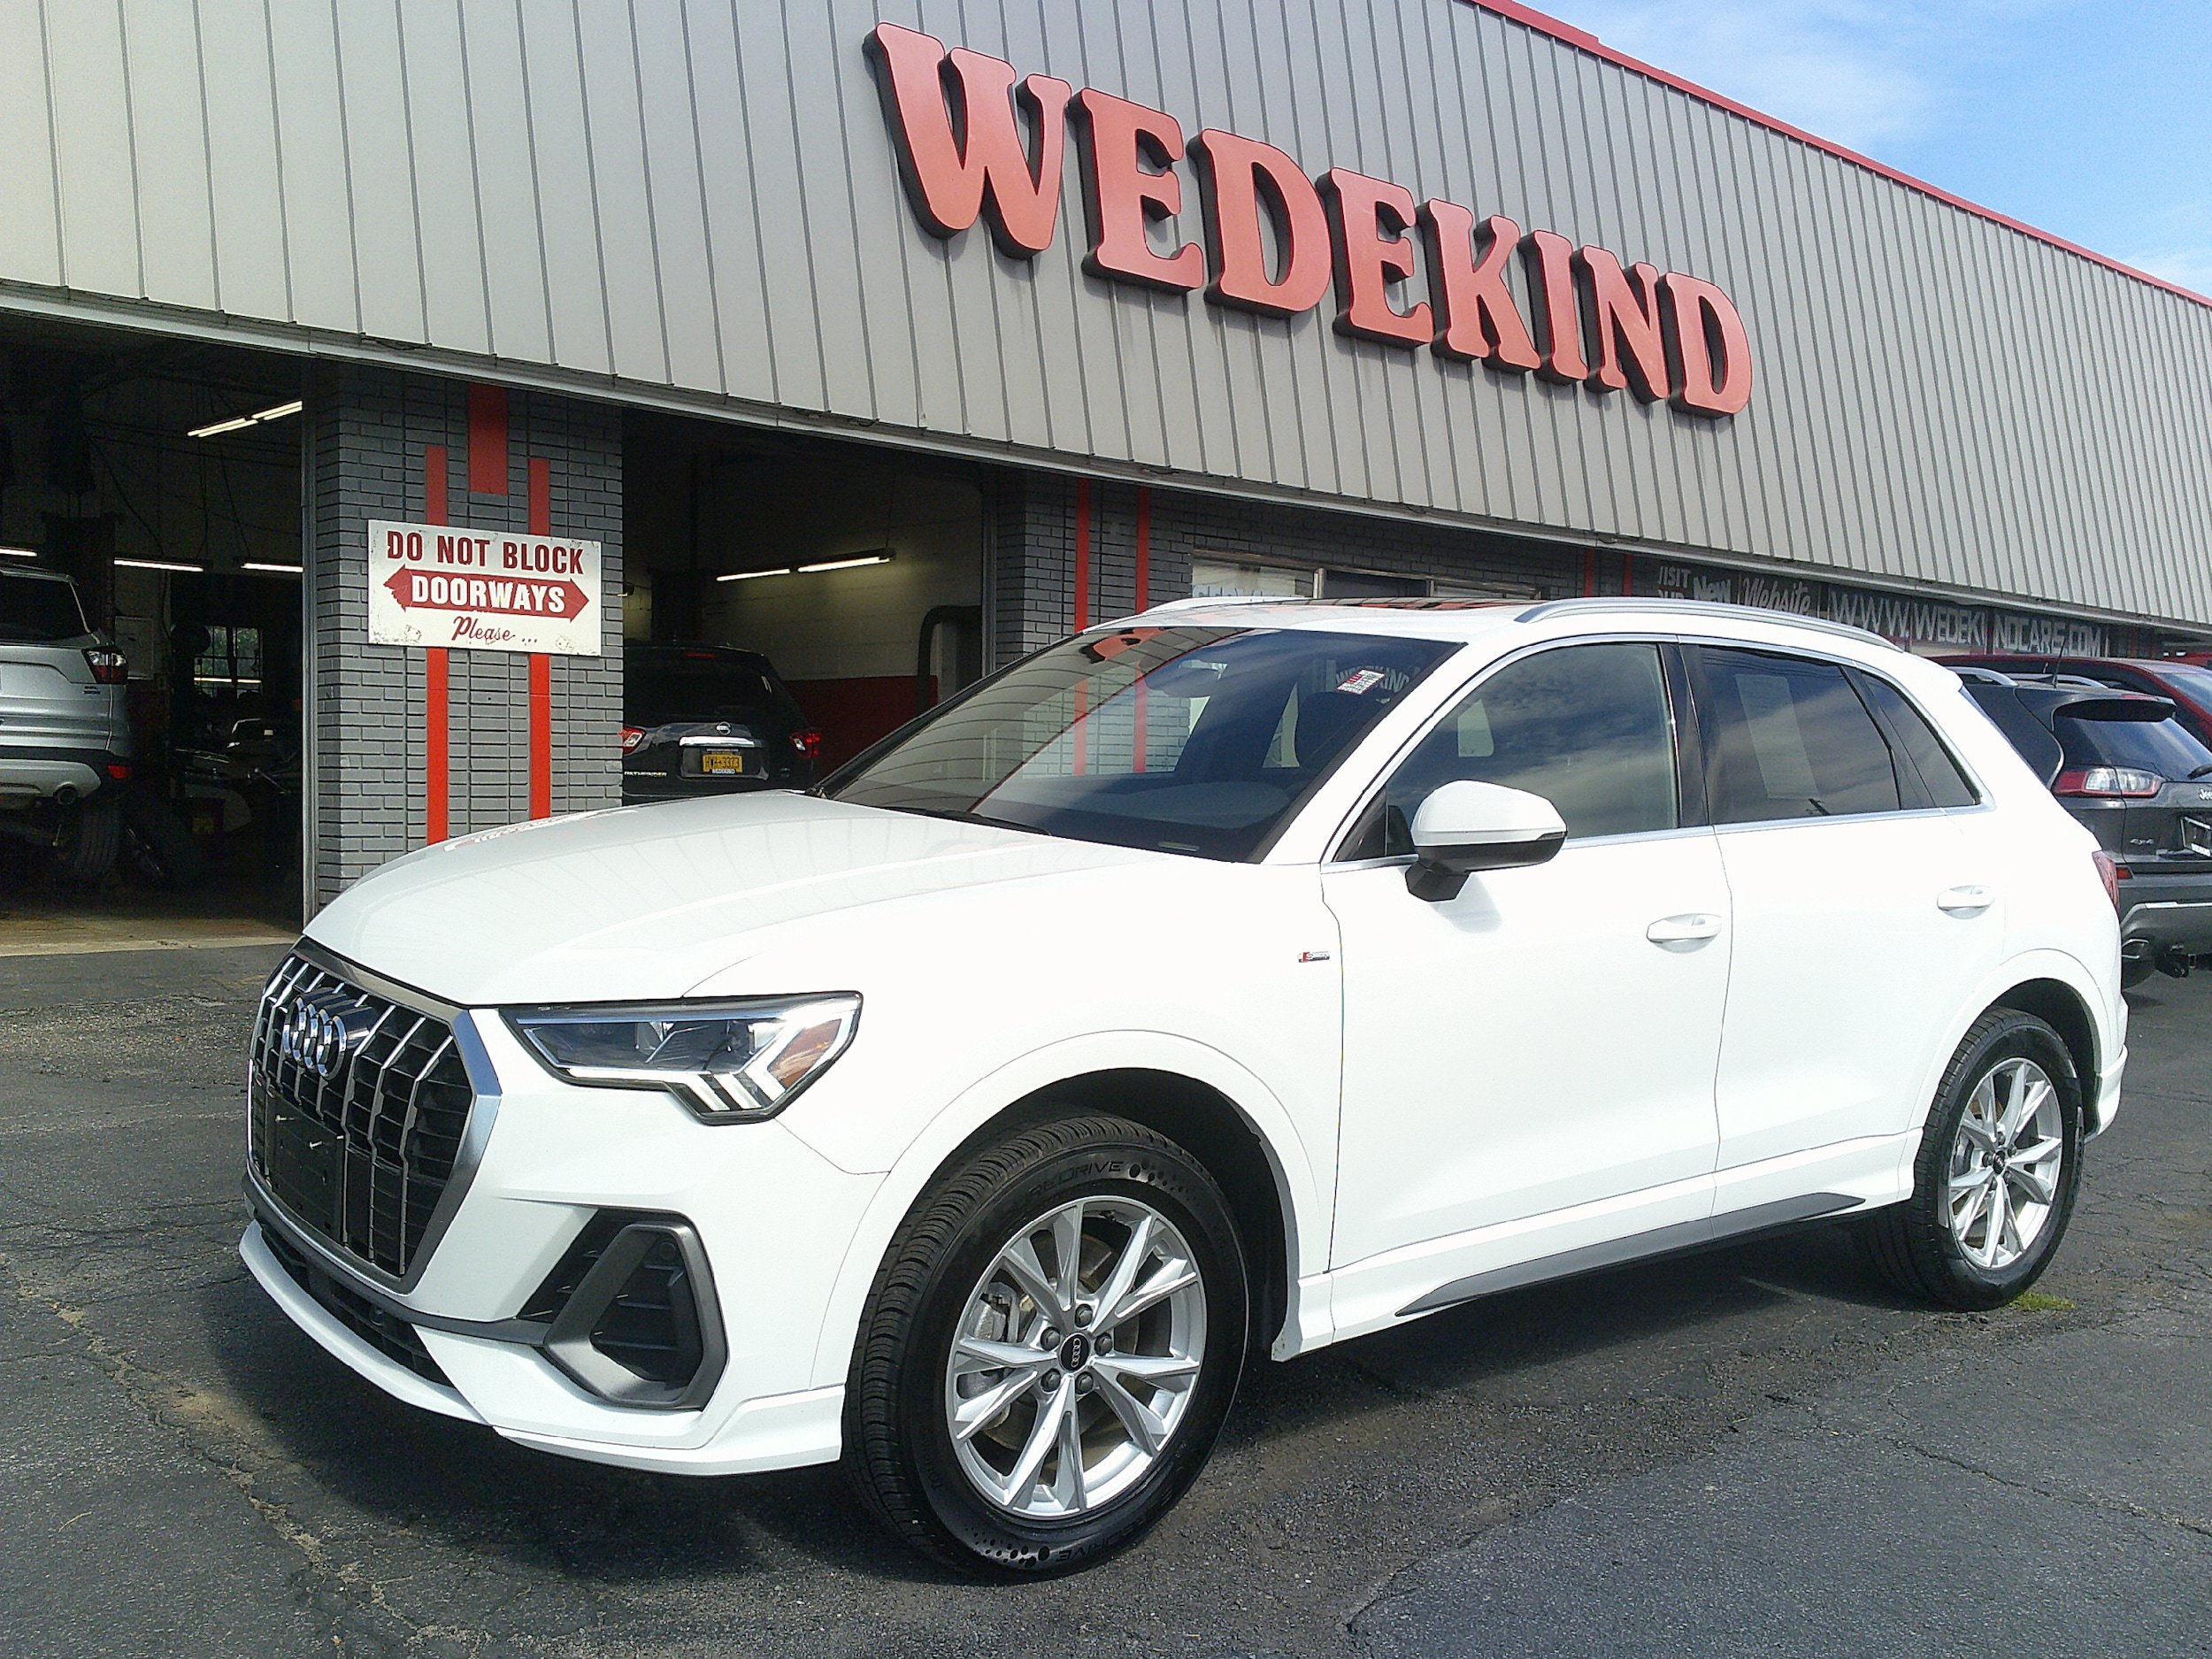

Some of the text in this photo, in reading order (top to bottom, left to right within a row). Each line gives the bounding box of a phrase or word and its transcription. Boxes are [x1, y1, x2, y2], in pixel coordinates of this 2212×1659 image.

[865, 21, 1752, 418] WEDEKIND
[387, 530, 584, 575] DO NOT BLOCK
[411, 574, 565, 613] DOORWAYS
[1742, 577, 1812, 616] Website
[450, 616, 517, 642] Please
